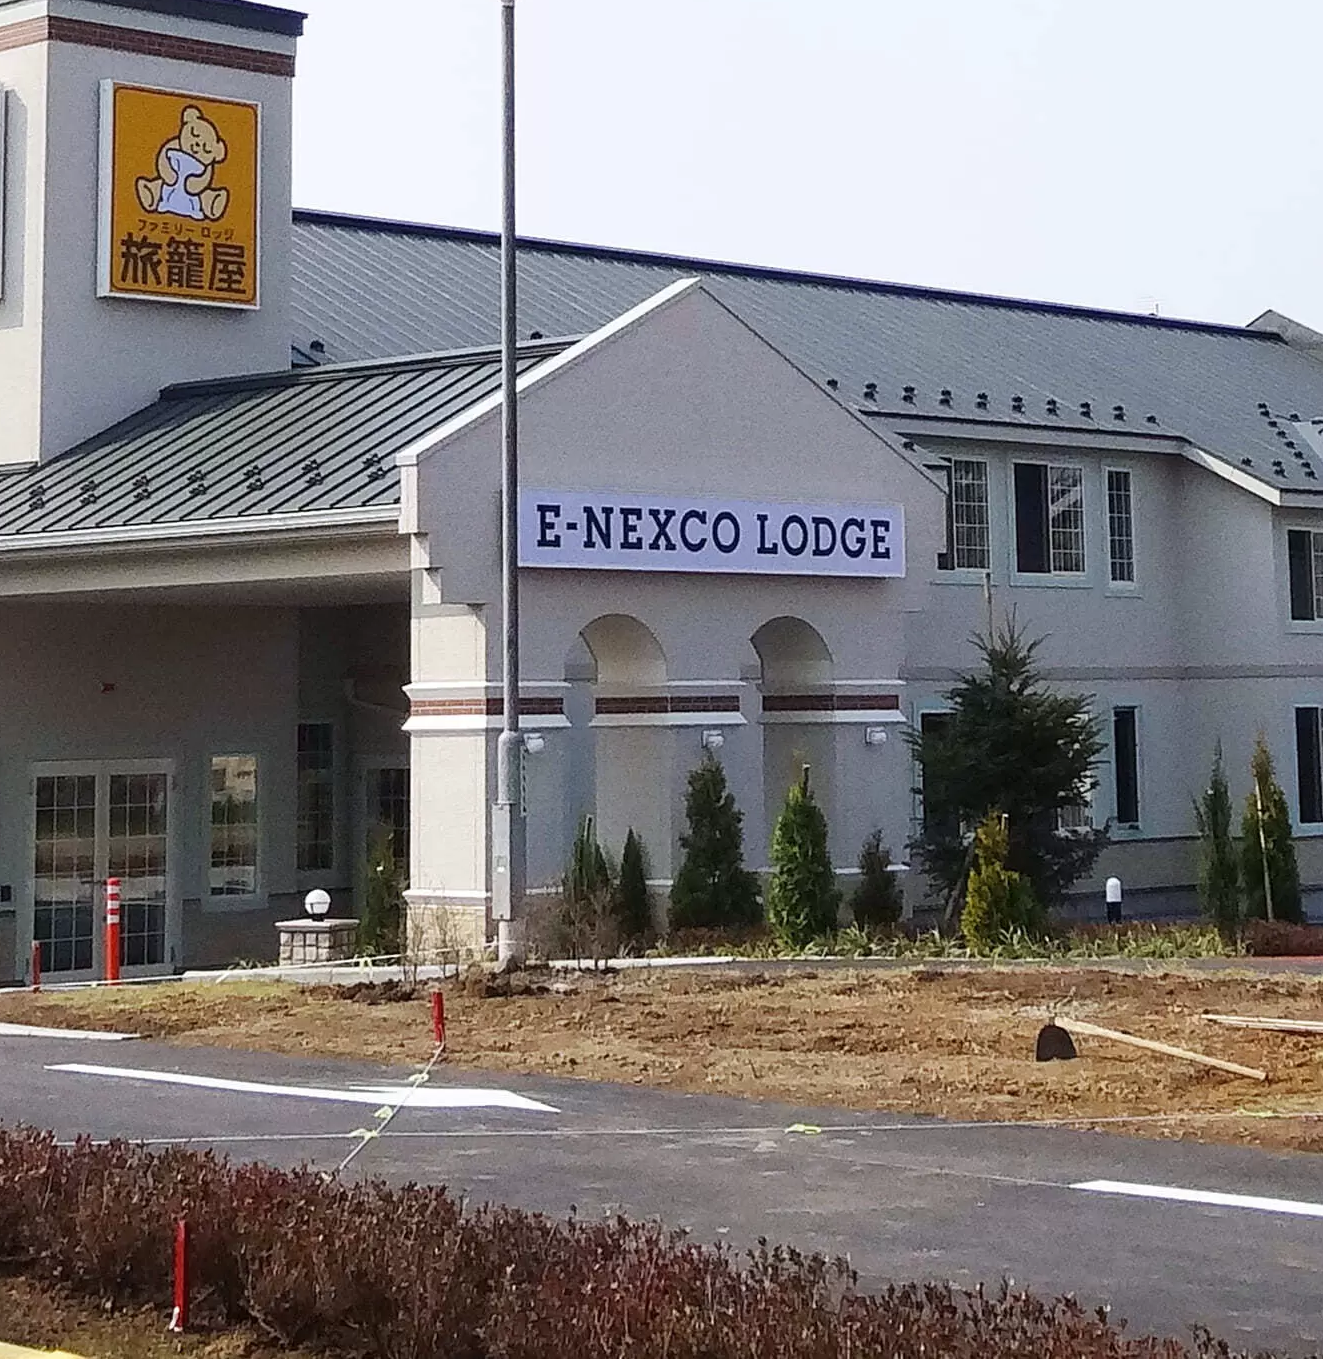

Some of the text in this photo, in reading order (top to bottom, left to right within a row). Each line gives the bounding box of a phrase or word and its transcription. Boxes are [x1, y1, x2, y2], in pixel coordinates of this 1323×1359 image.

[137, 218, 235, 241] ファミリー ロッジ
[120, 231, 247, 294] 旅籠屋
[536, 503, 891, 560] E-NEXCO LODGE
